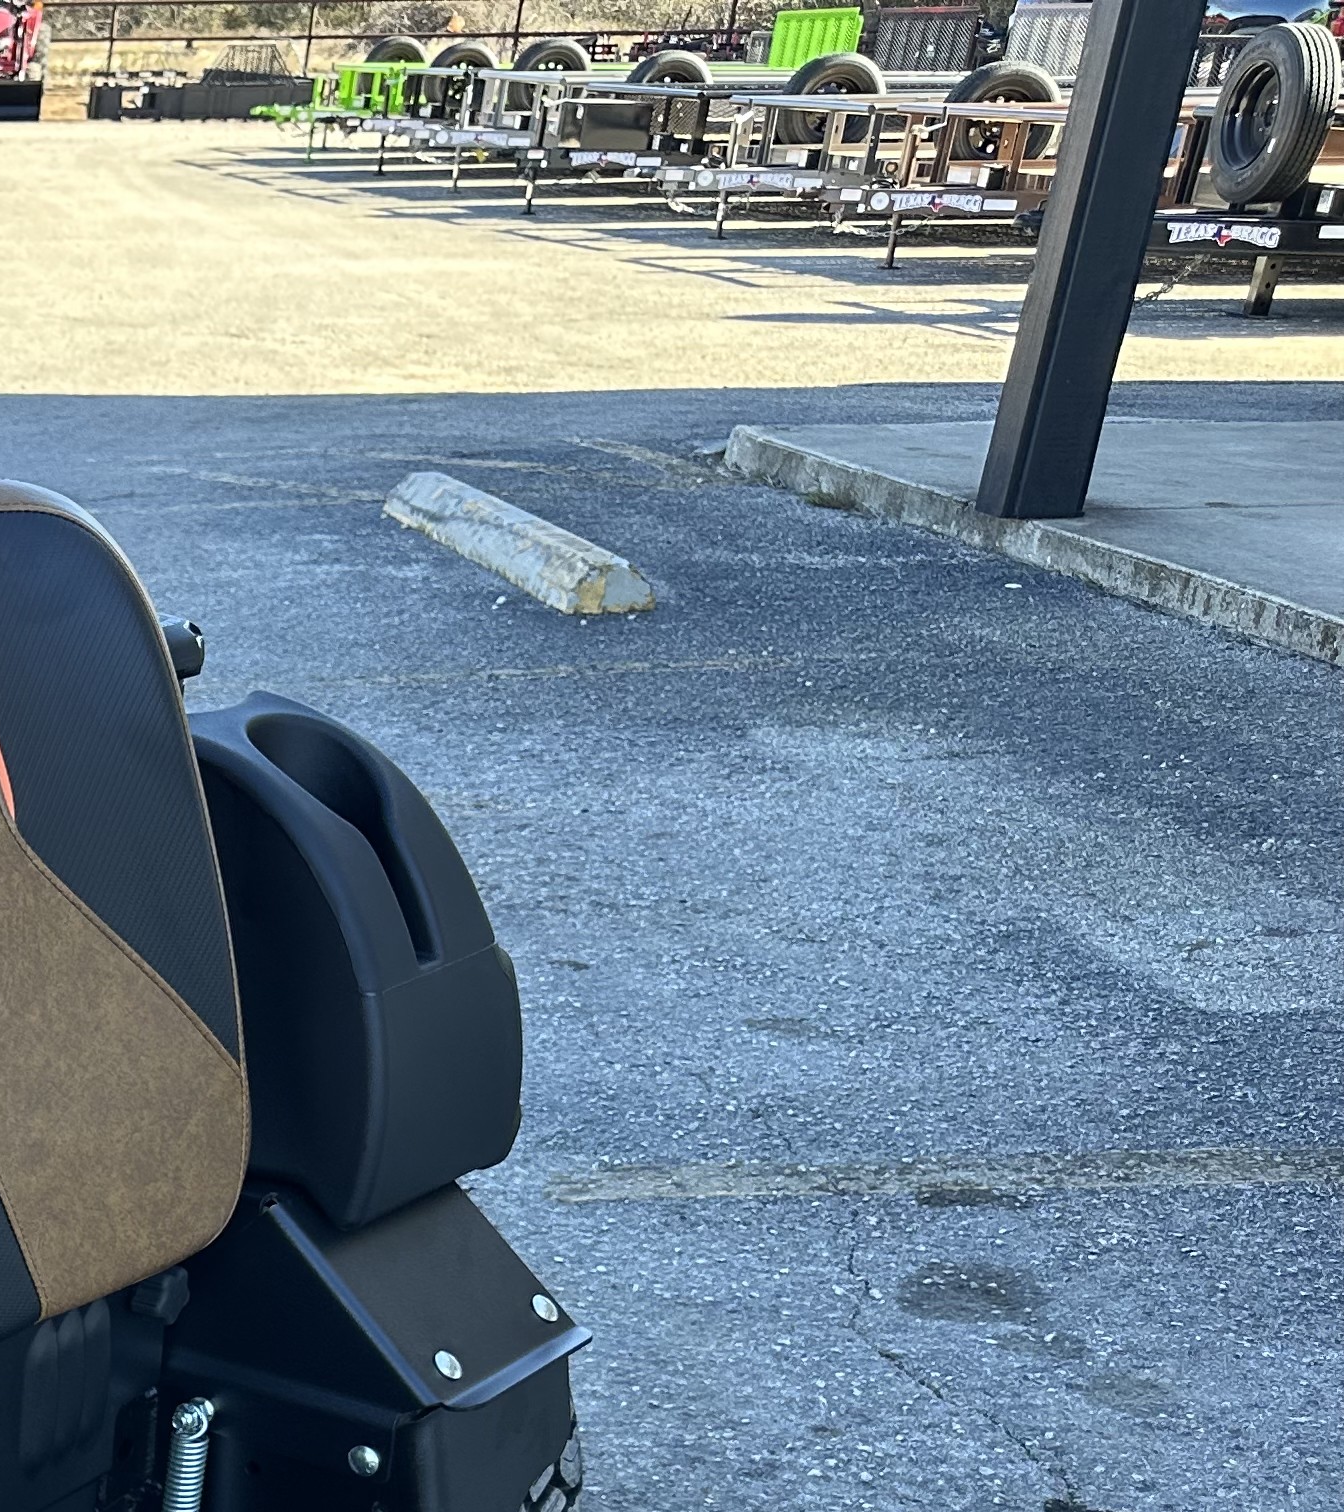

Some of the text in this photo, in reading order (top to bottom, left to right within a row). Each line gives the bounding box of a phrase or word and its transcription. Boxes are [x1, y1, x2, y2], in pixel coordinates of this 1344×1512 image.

[891, 193, 934, 211] TEXAS
[1167, 222, 1281, 248] TEXAS BRAGG
